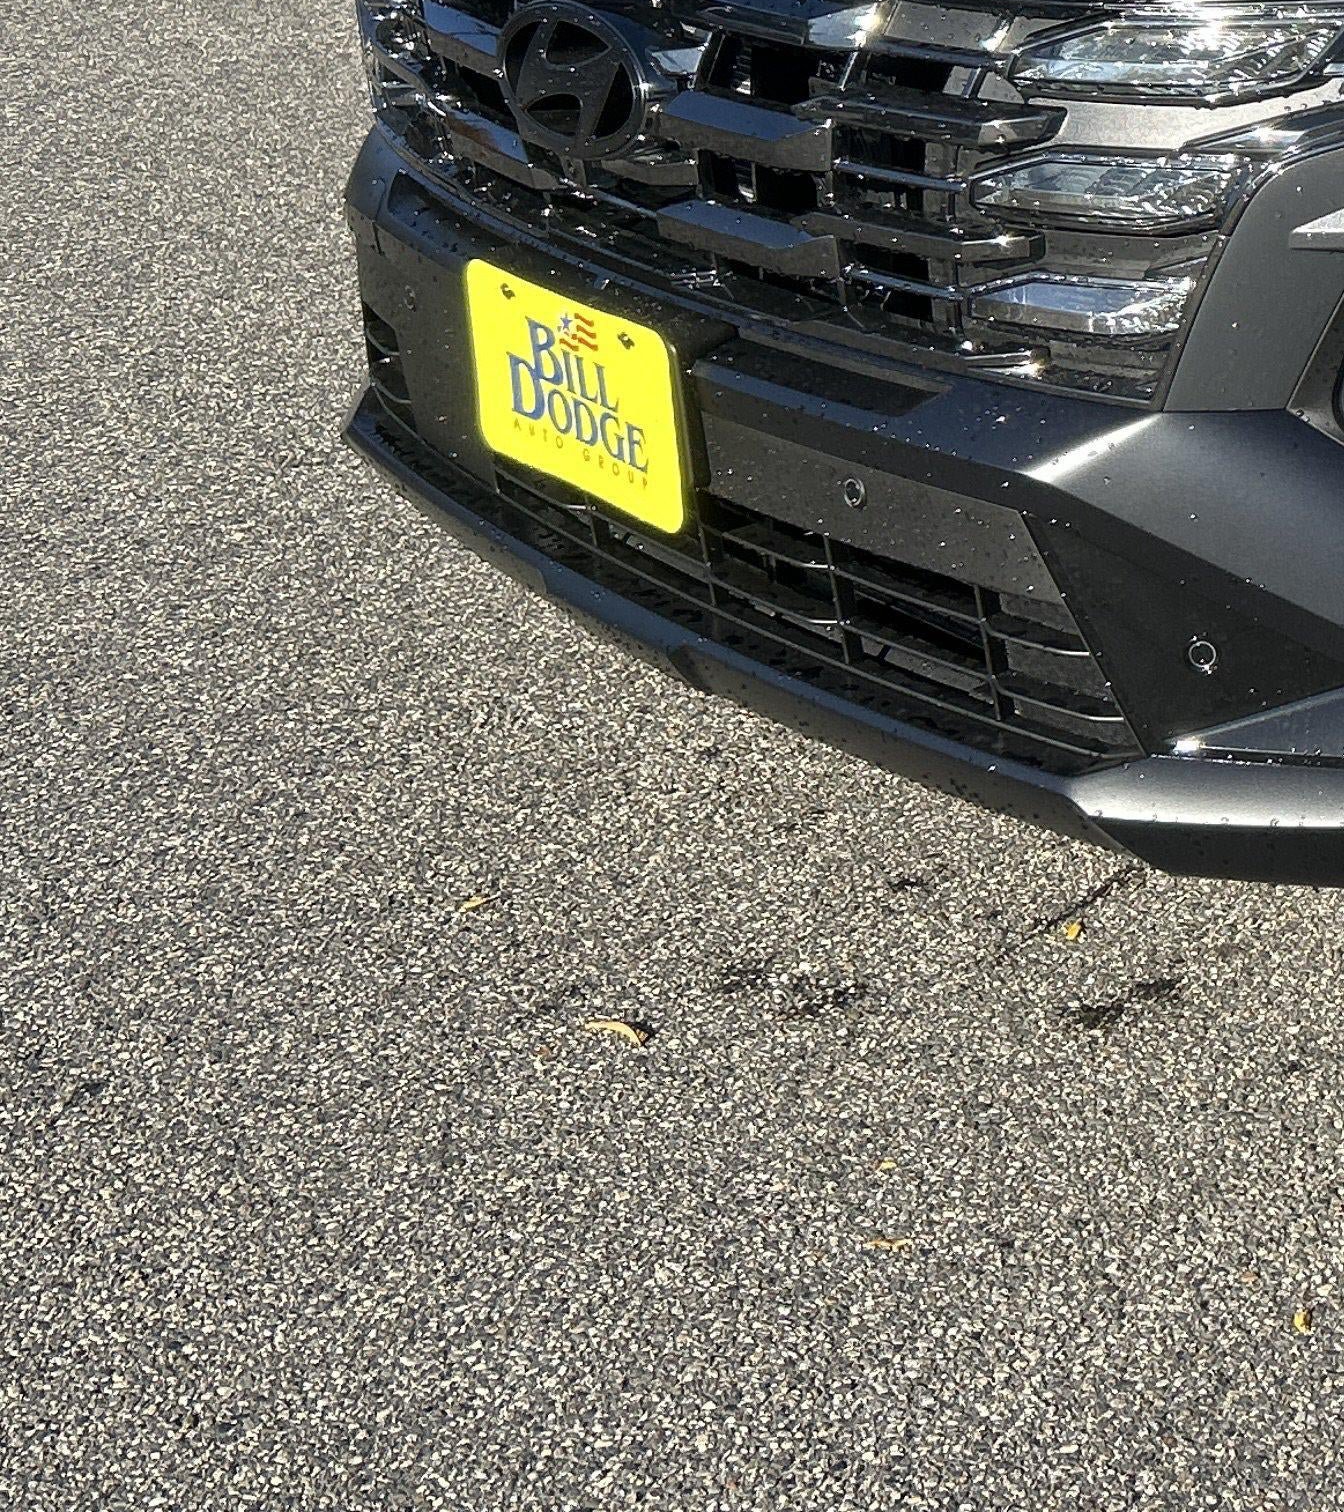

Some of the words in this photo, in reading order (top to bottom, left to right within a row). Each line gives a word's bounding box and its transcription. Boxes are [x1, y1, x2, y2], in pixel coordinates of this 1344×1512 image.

[506, 351, 649, 473] DODGE
[525, 315, 619, 412] BILL
[513, 418, 564, 449] AUTO
[582, 448, 648, 489] GROUP
